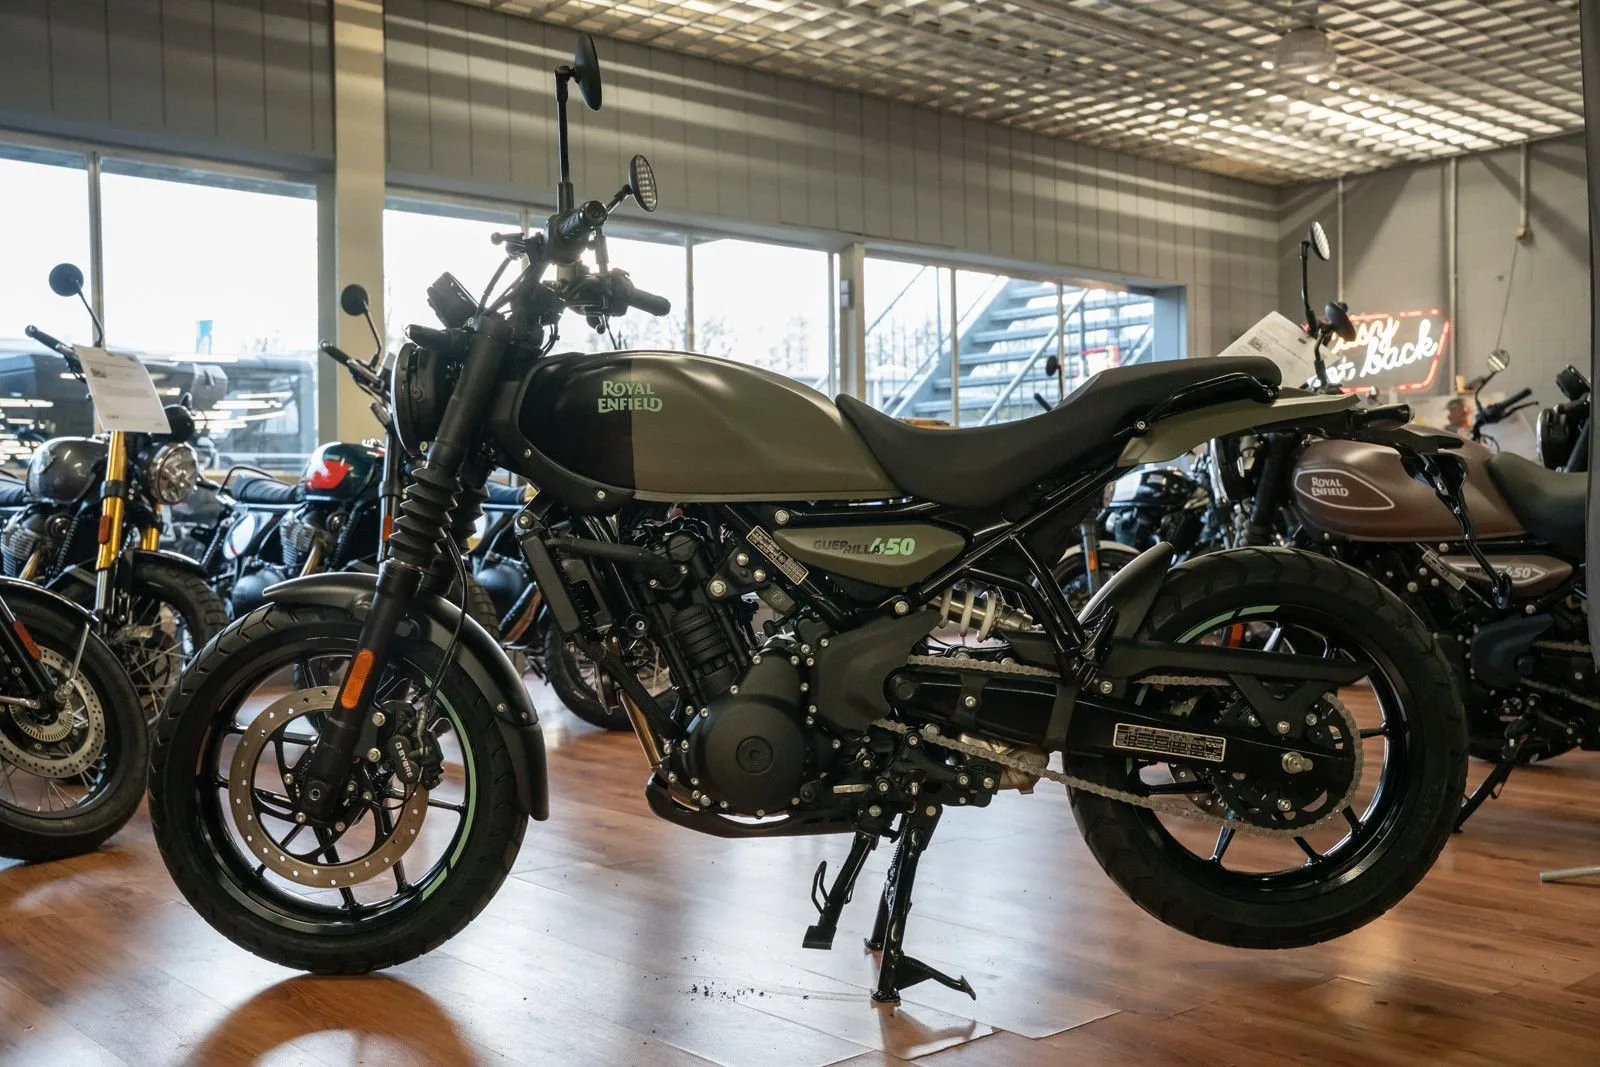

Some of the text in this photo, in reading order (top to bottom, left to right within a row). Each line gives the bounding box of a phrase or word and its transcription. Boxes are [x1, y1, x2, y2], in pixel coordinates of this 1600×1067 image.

[1360, 318, 1439, 378] back
[602, 380, 655, 397] ROYAL
[597, 398, 663, 413] ENFIELD
[1311, 477, 1342, 488] ROYAL
[1311, 487, 1349, 497] ENFIELD
[869, 537, 916, 556] 450
